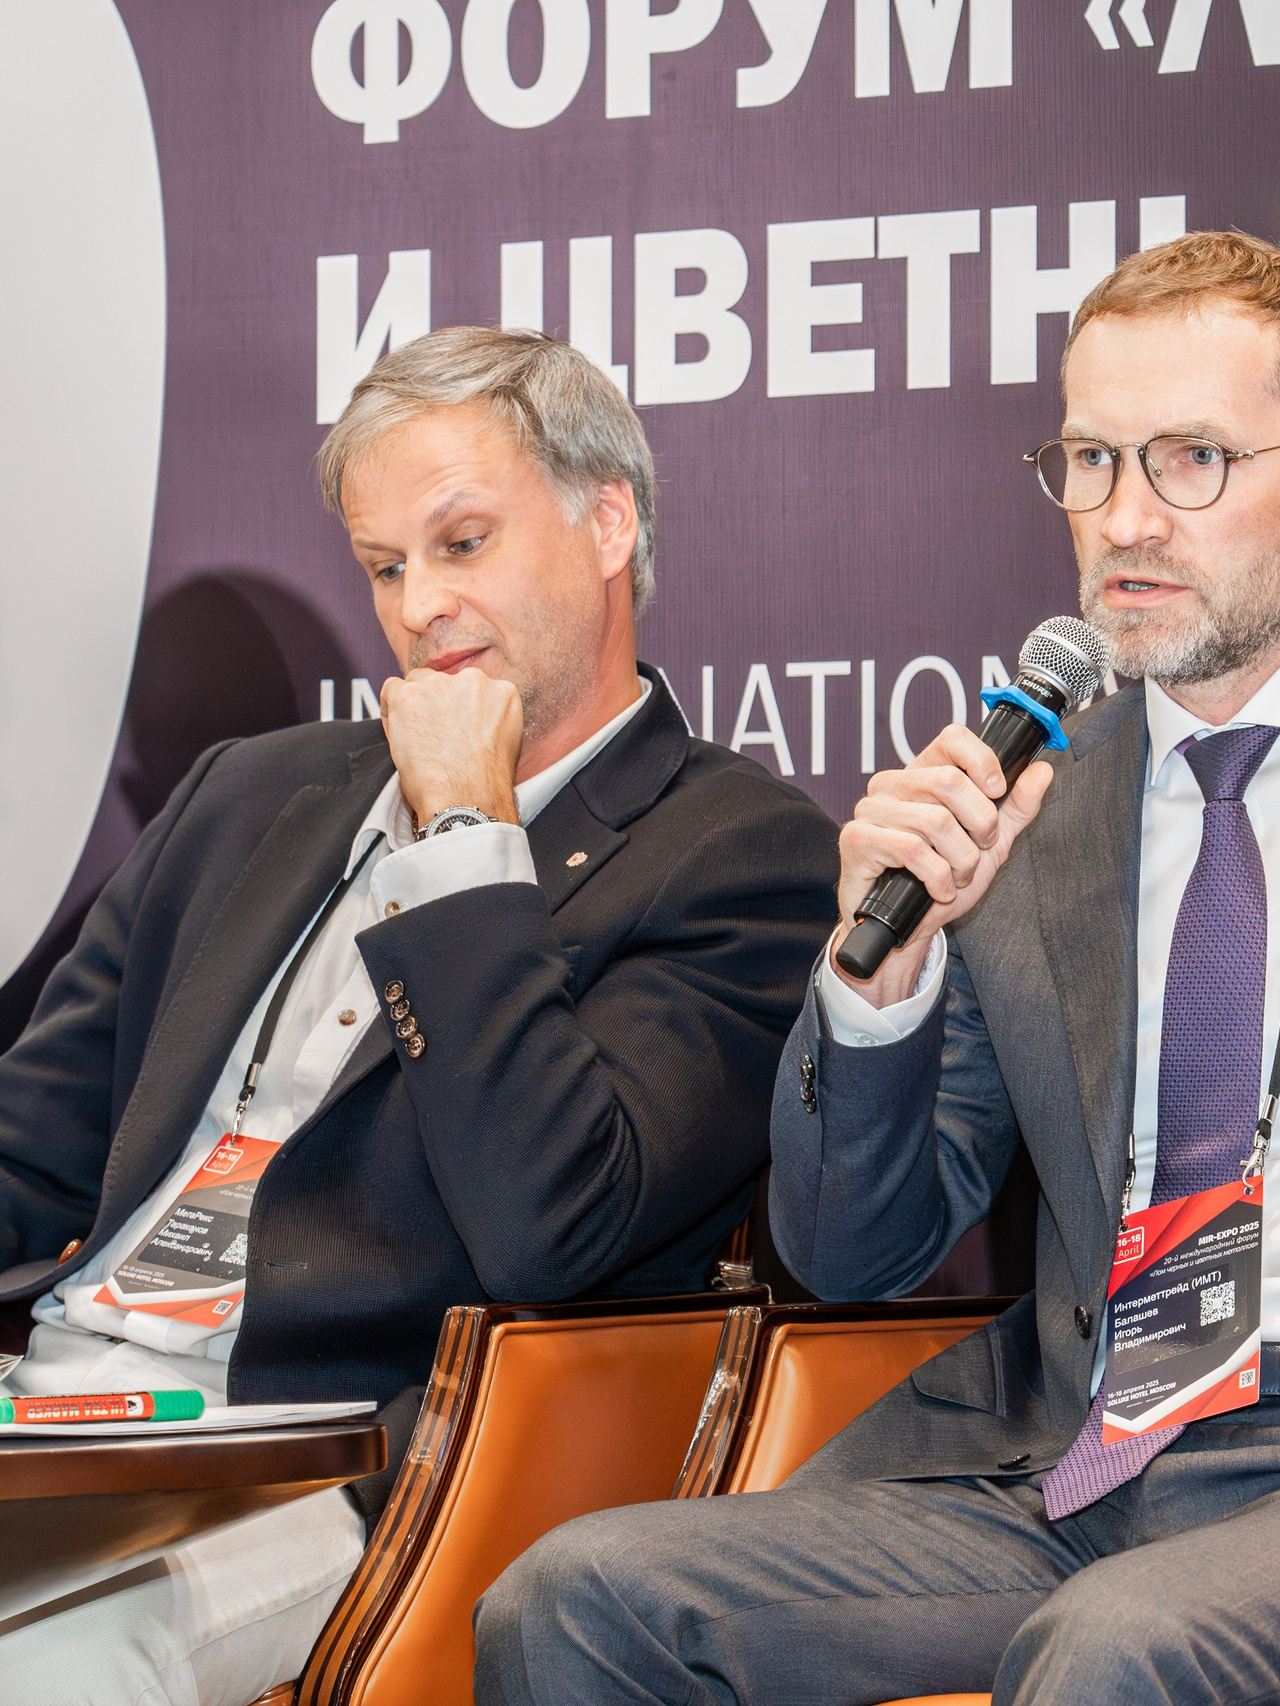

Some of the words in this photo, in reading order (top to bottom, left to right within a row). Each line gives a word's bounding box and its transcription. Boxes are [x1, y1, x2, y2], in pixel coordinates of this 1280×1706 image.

[1021, 679, 1051, 697] SHURE
[1117, 1234, 1141, 1247] 16-18
[1198, 1227, 1238, 1246] MIR-EXPO
[1239, 1221, 1260, 1234] 2025
[1118, 1244, 1139, 1258] April
[1114, 1283, 1189, 1313] Интерметтрейд
[1191, 1270, 1222, 1290] (ИМТ)
[1114, 1307, 1159, 1328] Балашев
[1114, 1326, 1143, 1340] Игорь
[1114, 1323, 1186, 1352] Владимирович
[1149, 1381, 1176, 1395] MOSCOW
